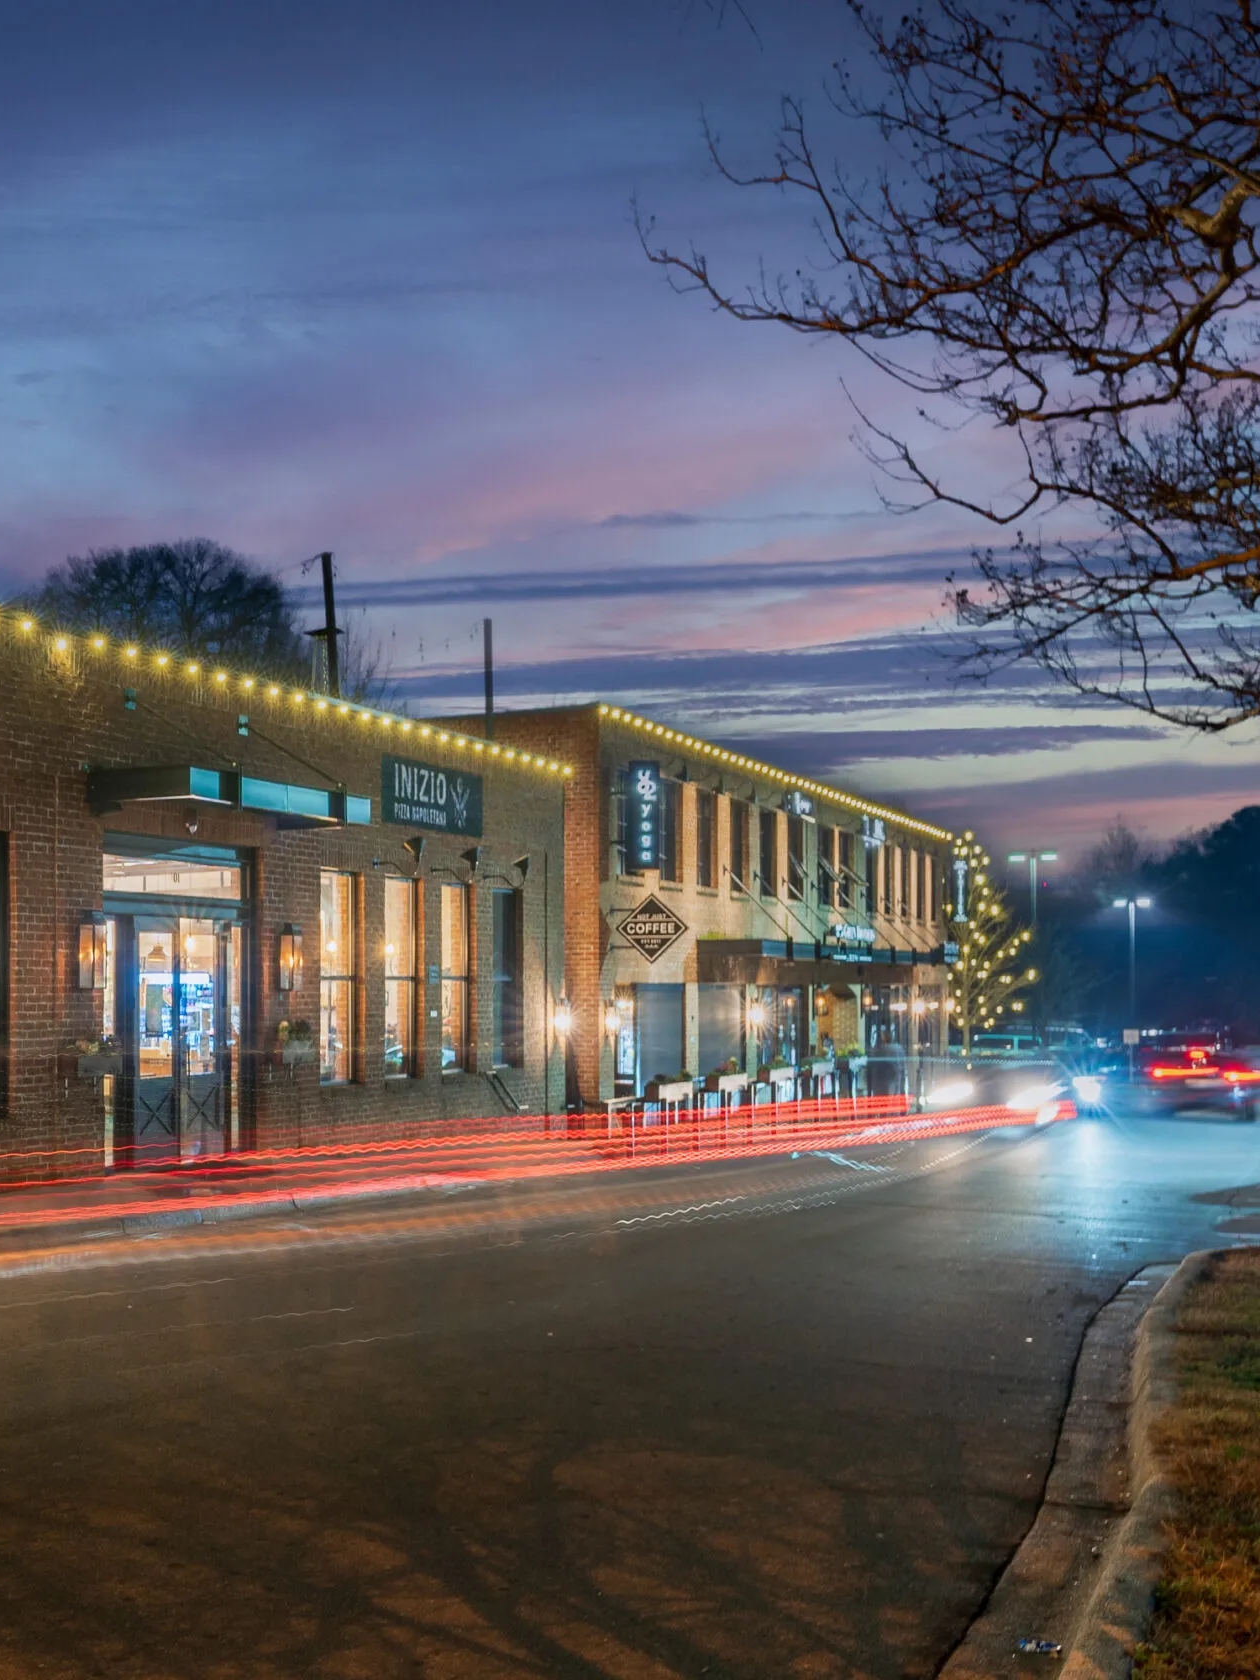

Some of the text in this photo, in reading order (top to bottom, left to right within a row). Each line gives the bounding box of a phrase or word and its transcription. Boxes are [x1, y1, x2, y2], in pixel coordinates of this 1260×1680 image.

[394, 763, 447, 805] INIZIO
[641, 803, 652, 861] yoga
[626, 922, 675, 934] COFFEE
